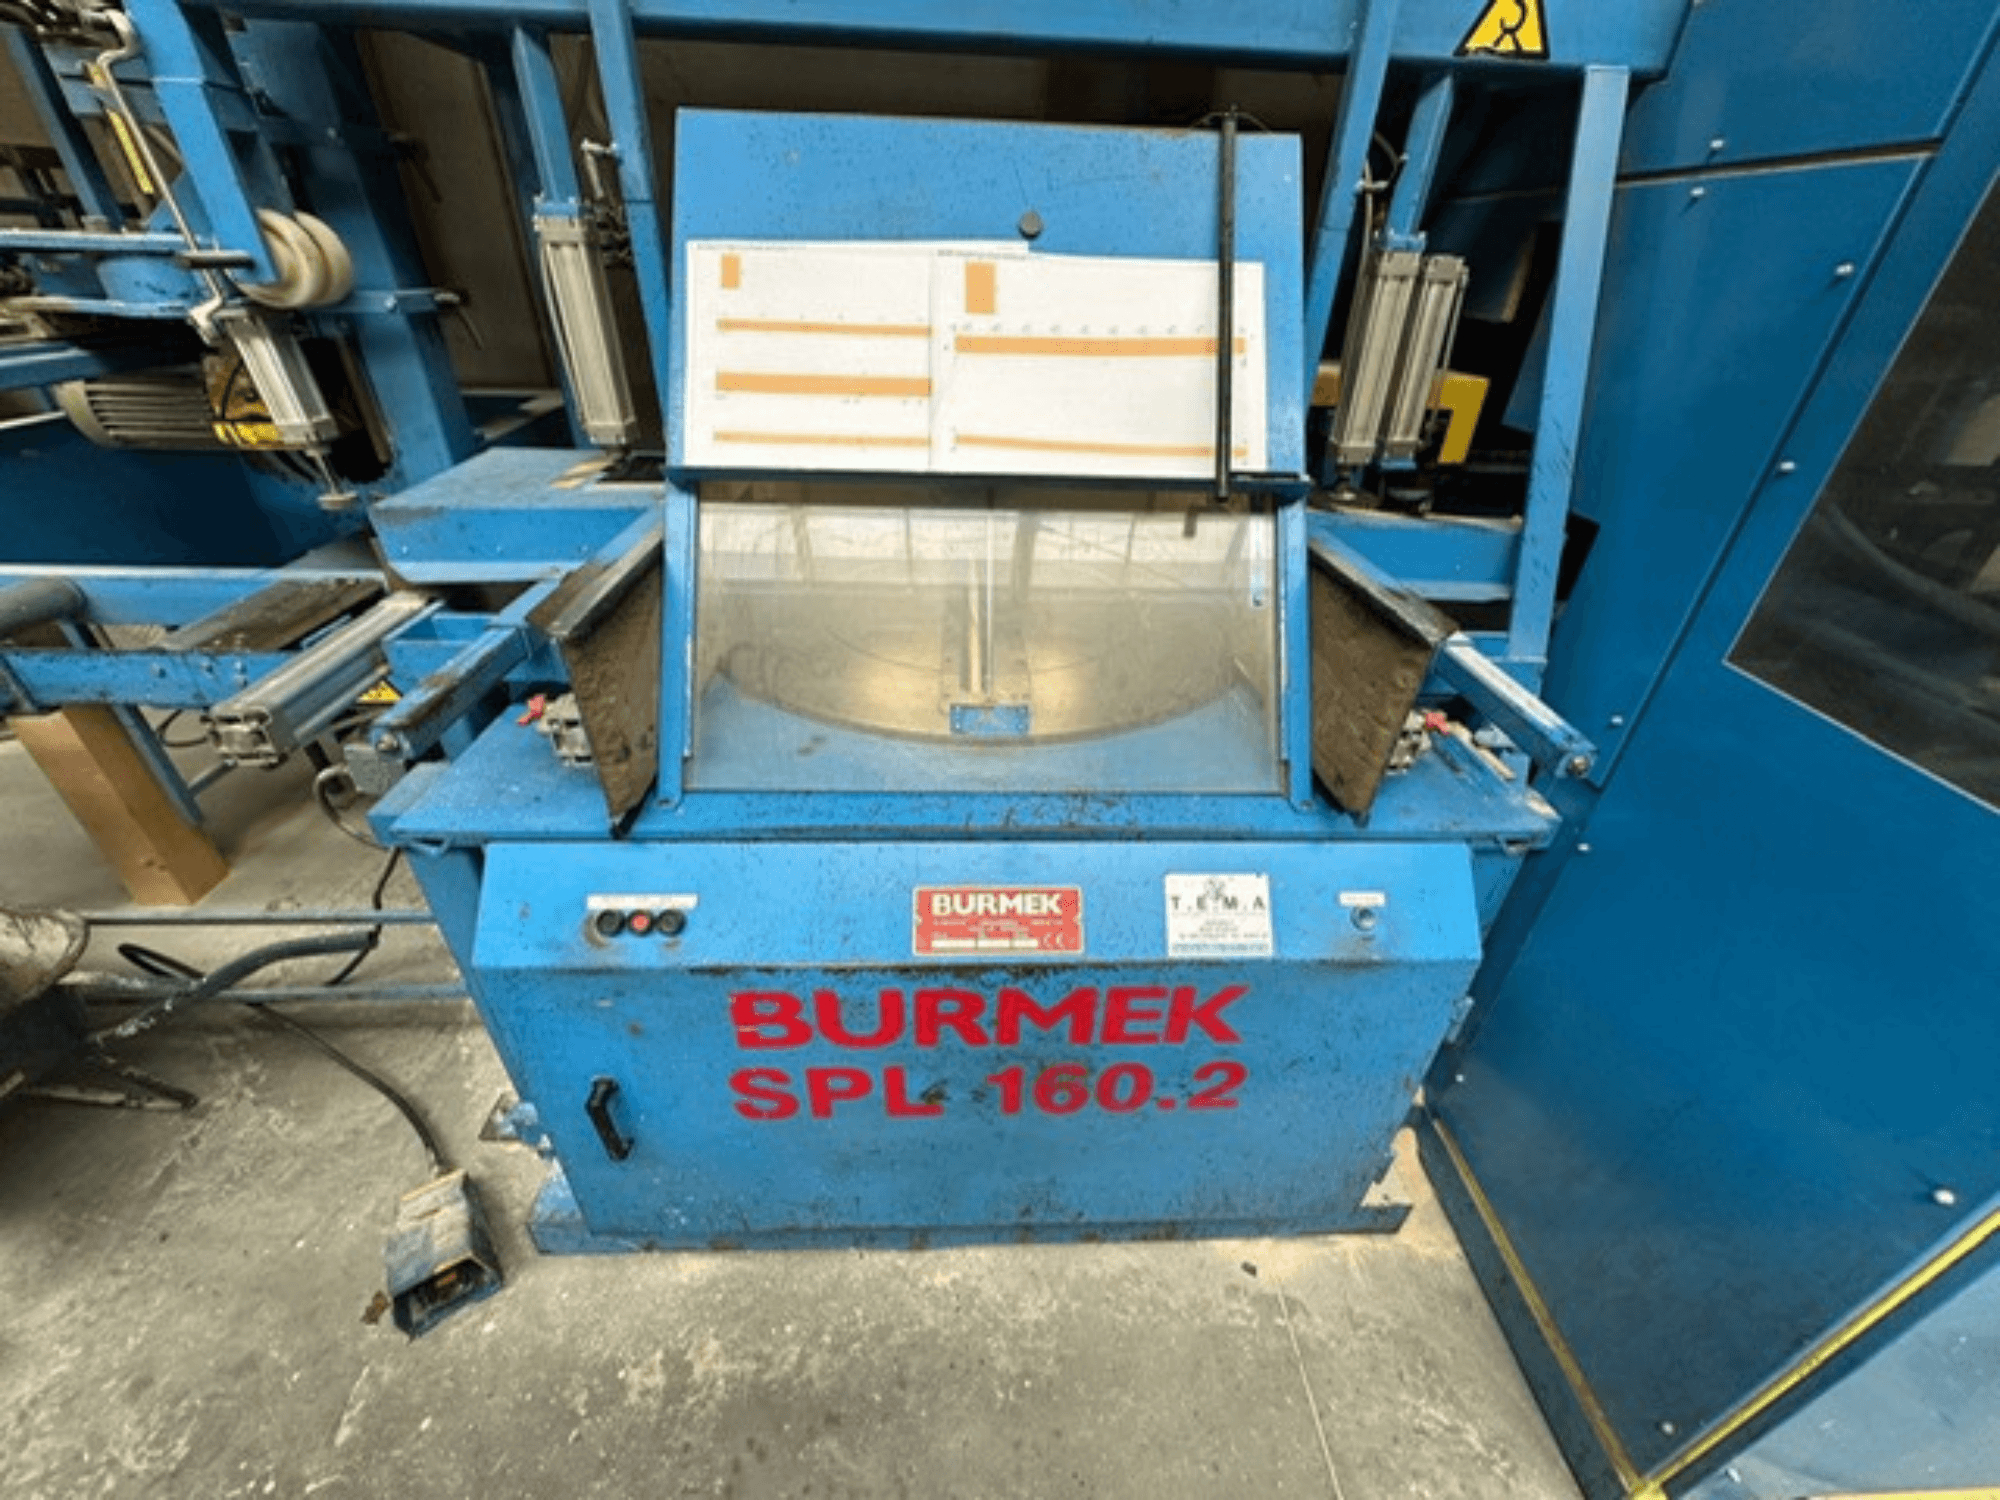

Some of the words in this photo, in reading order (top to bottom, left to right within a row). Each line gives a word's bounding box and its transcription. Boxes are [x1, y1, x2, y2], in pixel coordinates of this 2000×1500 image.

[931, 893, 1062, 916] BURMEK
[729, 985, 1249, 1049] BURMEK
[729, 1066, 945, 1120] SPL
[986, 1060, 1249, 1116] 160.2
